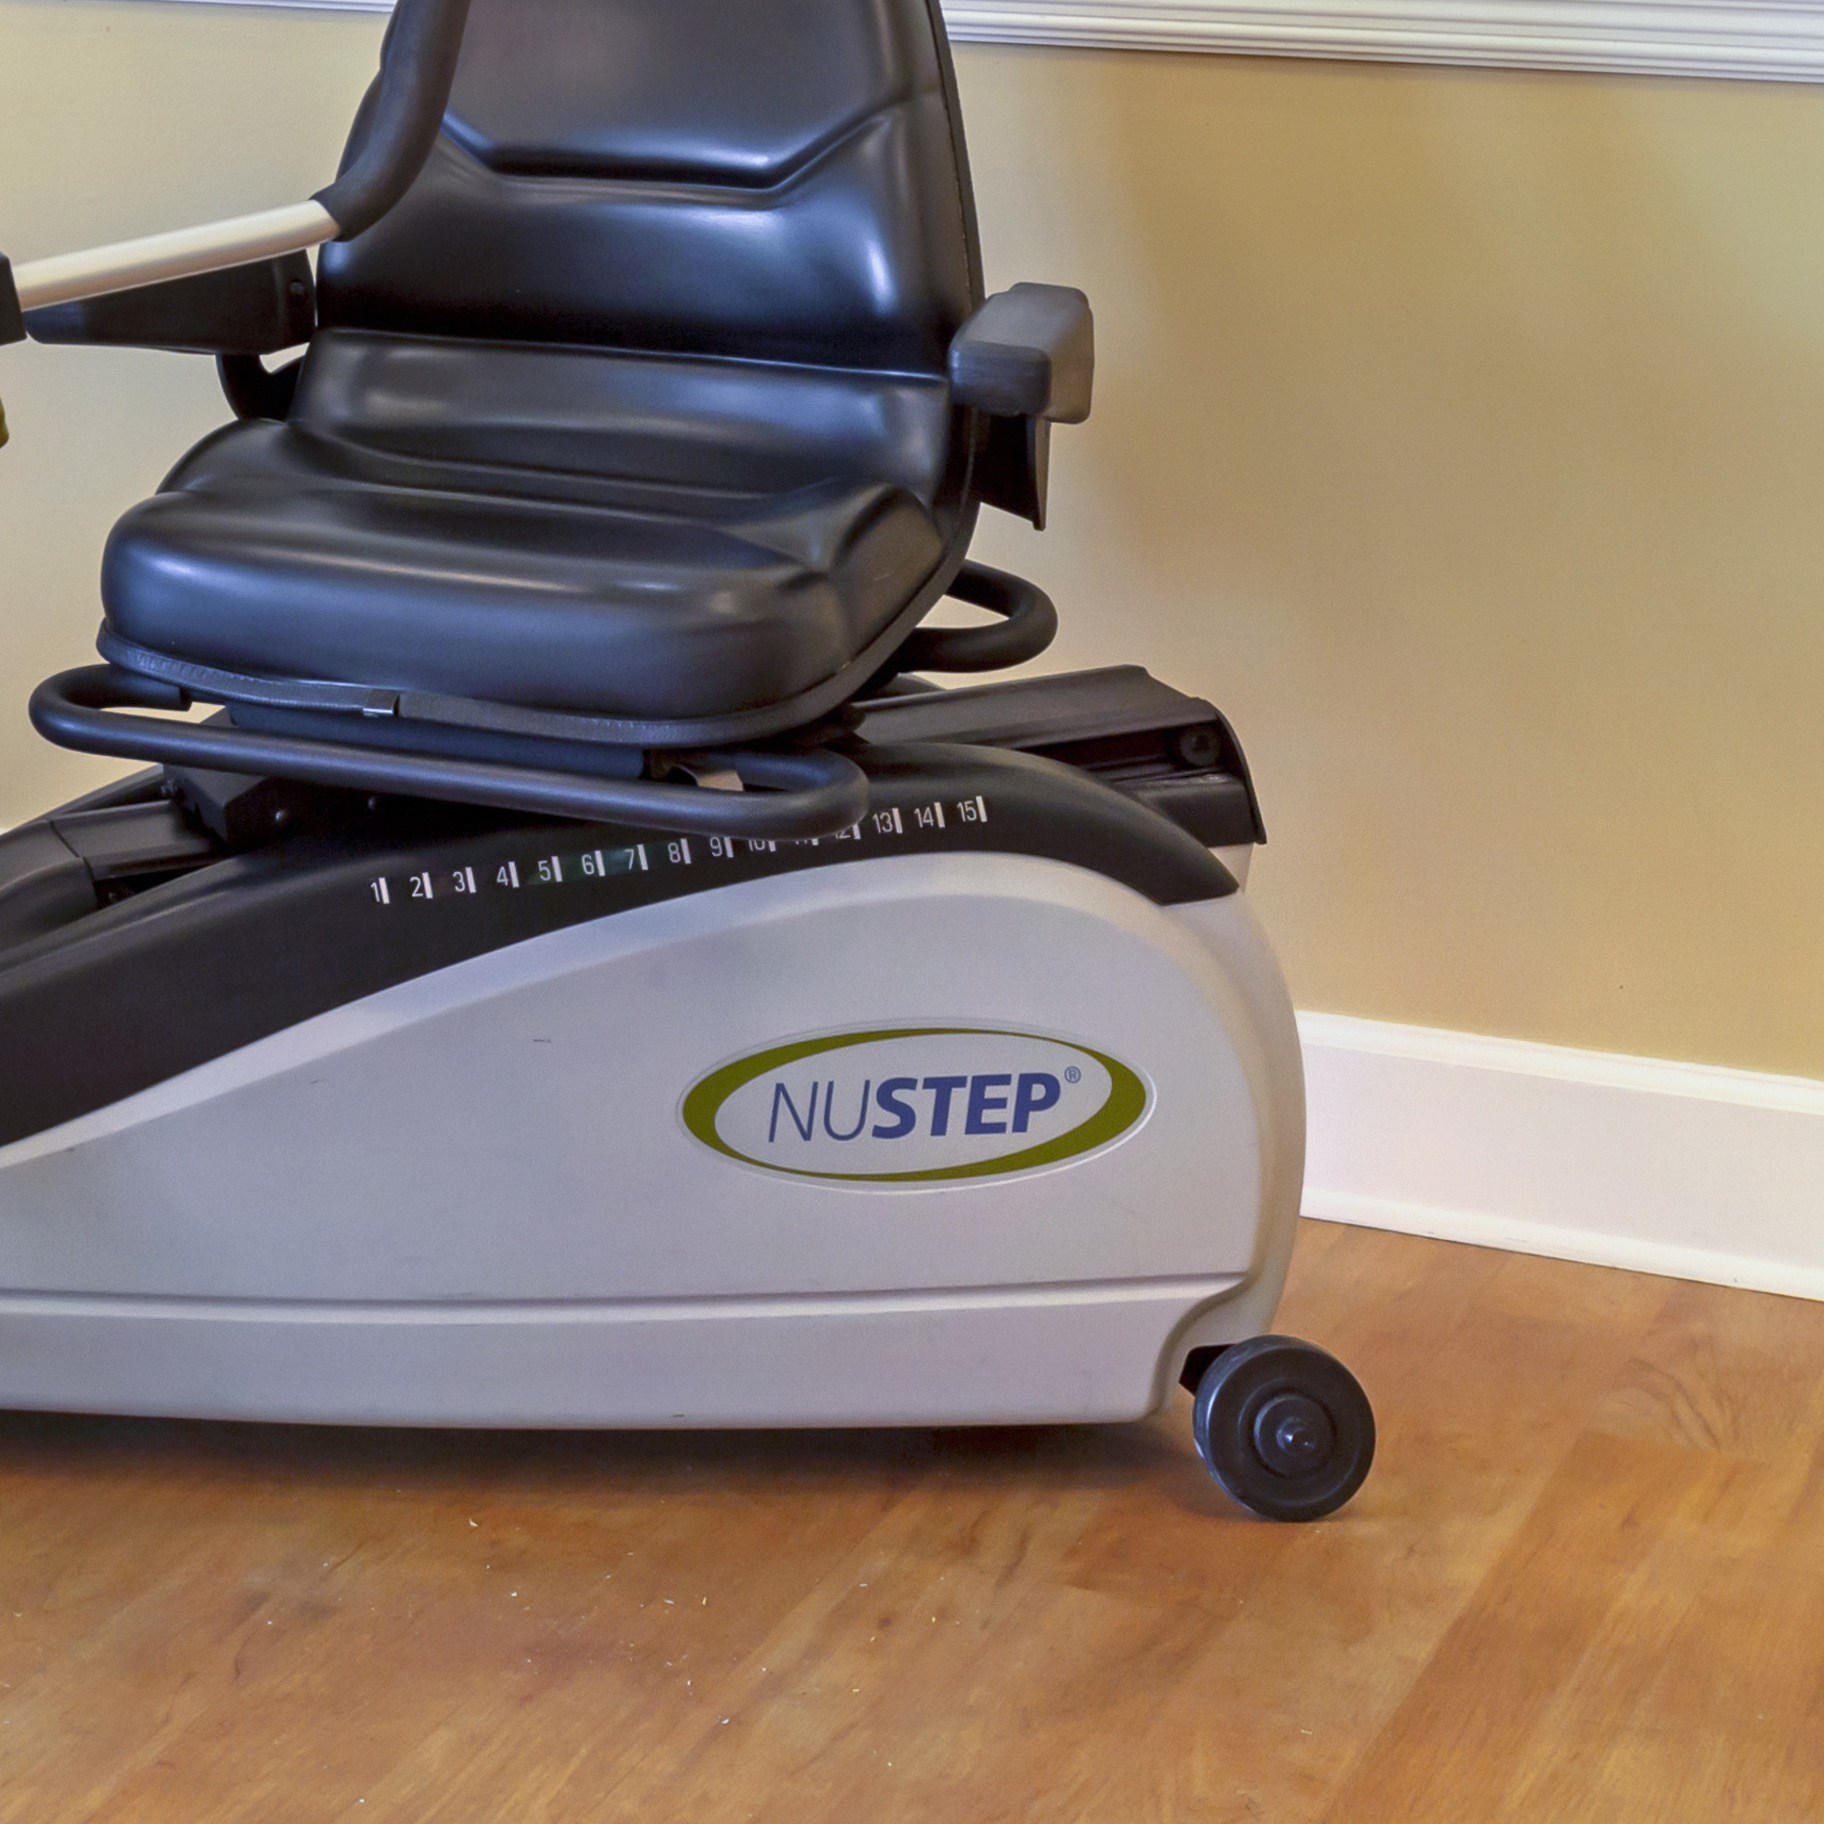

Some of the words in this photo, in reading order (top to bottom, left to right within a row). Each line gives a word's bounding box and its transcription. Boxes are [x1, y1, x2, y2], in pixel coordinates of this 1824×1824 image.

[371, 881, 381, 903] 1
[409, 876, 424, 898] 2
[452, 871, 466, 893] 3
[496, 865, 509, 887] 4
[538, 860, 551, 881] 5
[581, 854, 595, 875] 6
[624, 848, 635, 870] 7
[667, 842, 681, 864] 8
[709, 836, 723, 857] 9
[872, 811, 893, 834] 13
[914, 807, 934, 828] 14
[956, 800, 977, 822] 15
